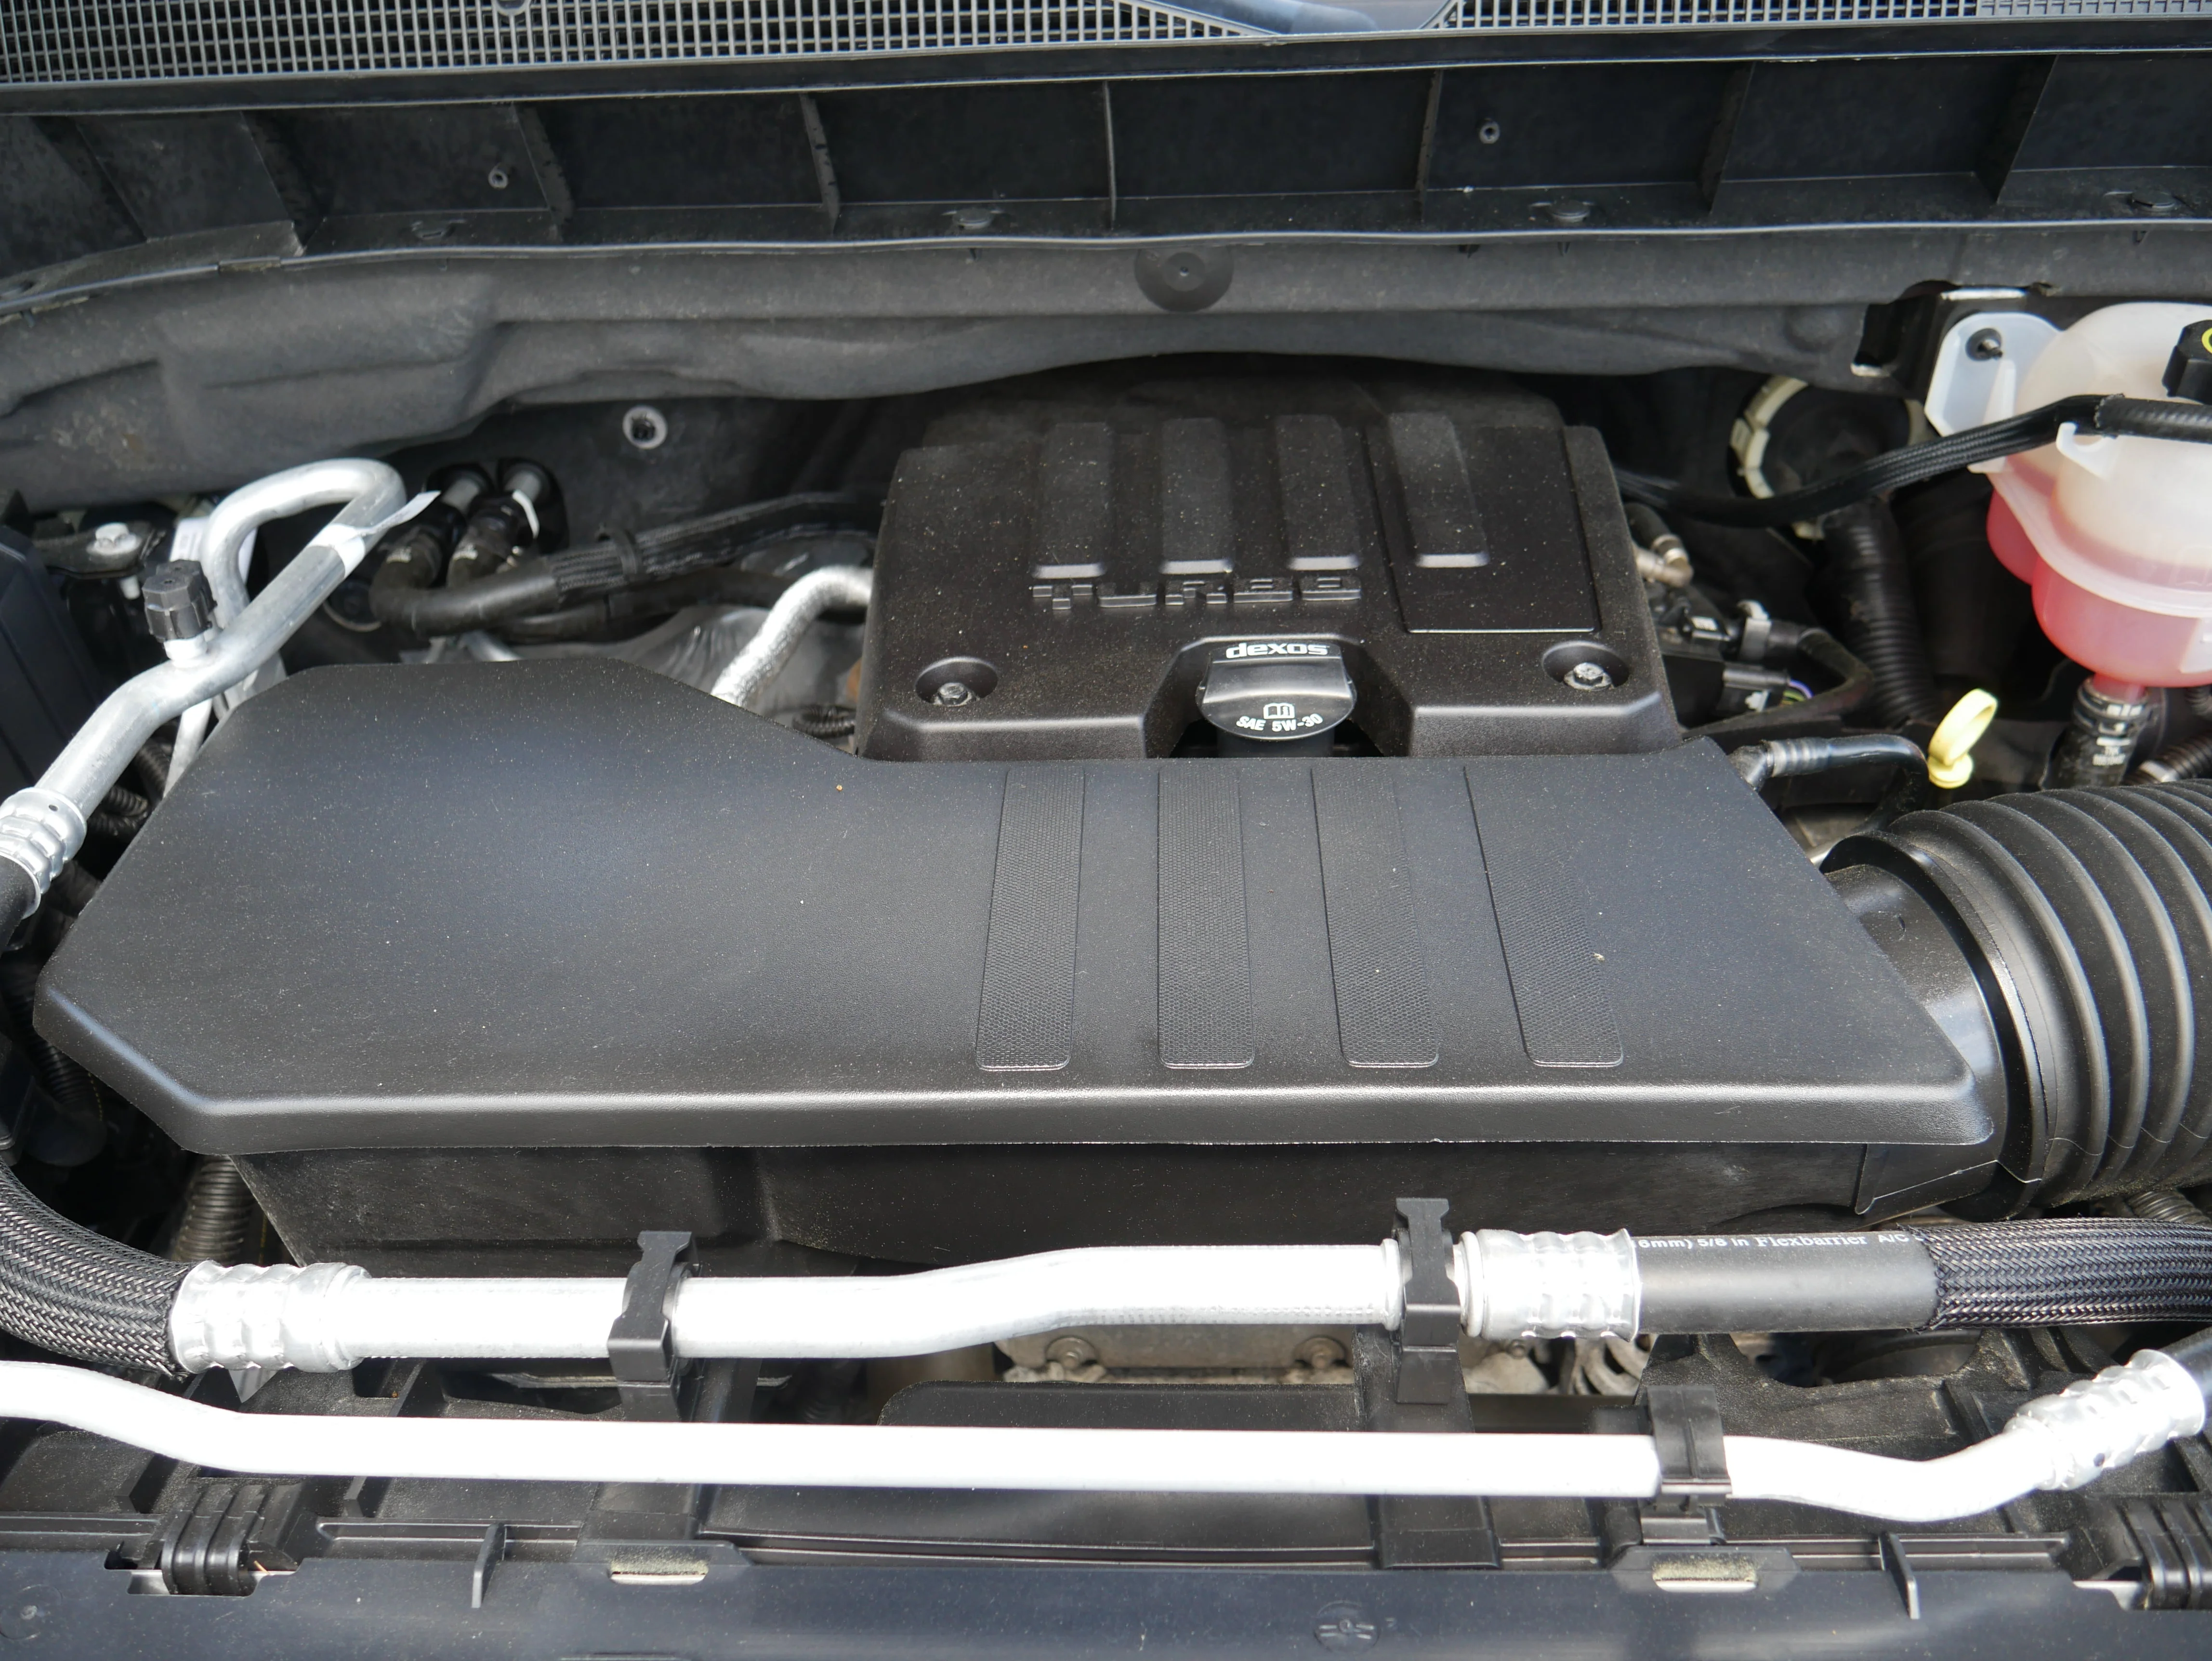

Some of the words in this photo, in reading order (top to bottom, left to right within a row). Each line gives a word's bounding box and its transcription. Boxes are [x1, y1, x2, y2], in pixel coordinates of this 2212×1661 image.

[1032, 577, 1361, 610] TURBO
[1226, 643, 1328, 659] dexos
[1236, 716, 1266, 731] SAE
[1272, 713, 1323, 732] 5W-30
[1697, 1238, 1727, 1247] 5/8
[1754, 1235, 1868, 1247] Flexbarrier
[1878, 1234, 1909, 1242] A/C
